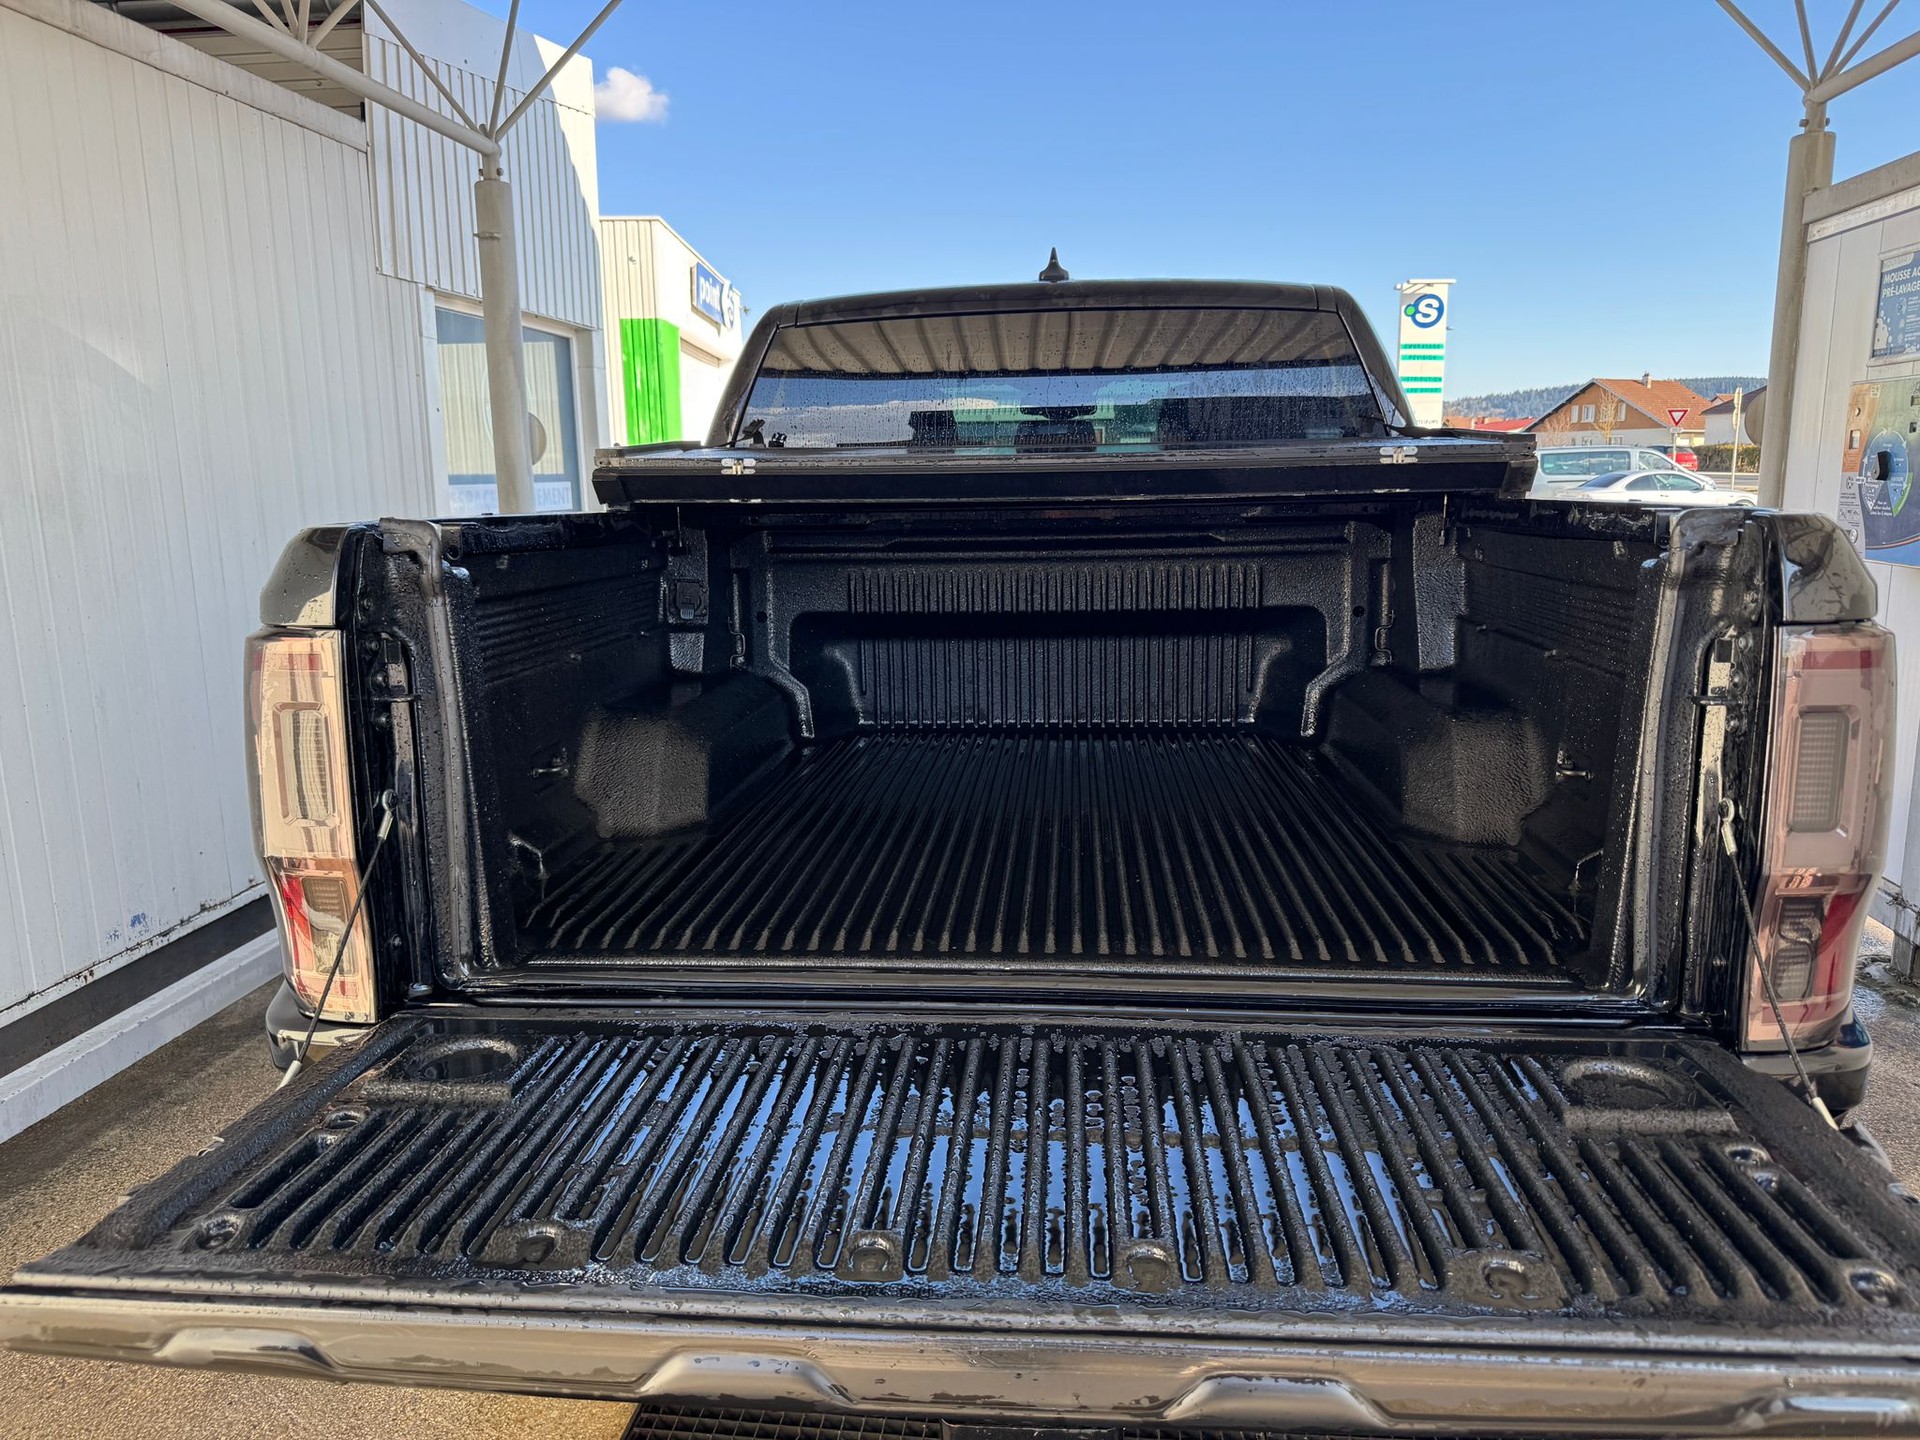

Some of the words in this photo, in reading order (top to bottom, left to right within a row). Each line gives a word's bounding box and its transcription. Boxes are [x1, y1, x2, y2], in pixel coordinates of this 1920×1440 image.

[1883, 268, 1911, 284] MOUSSE
[699, 276, 721, 311] point
[1415, 297, 1440, 323] S
[536, 487, 570, 506] EMENT
